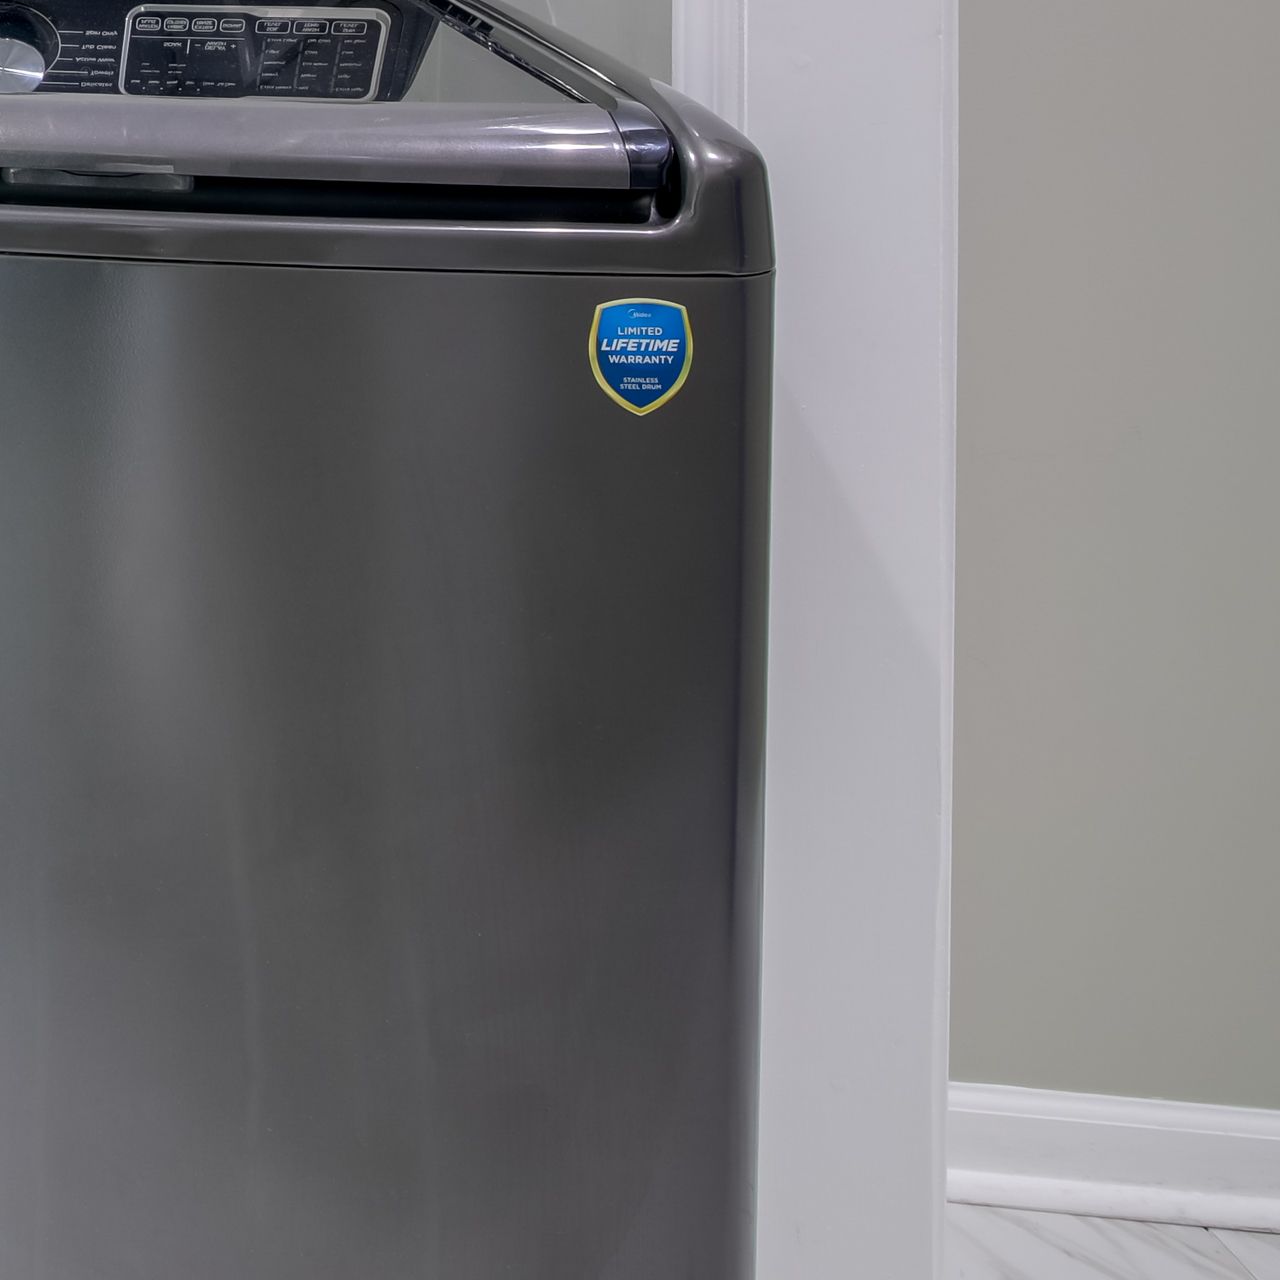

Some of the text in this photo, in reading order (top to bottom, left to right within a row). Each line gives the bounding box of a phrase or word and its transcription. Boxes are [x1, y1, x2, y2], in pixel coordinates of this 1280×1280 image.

[617, 326, 663, 336] LIMITED
[600, 338, 680, 352] LIFETIME
[608, 354, 674, 364] WARRANTY
[623, 376, 658, 384] STAINLESS
